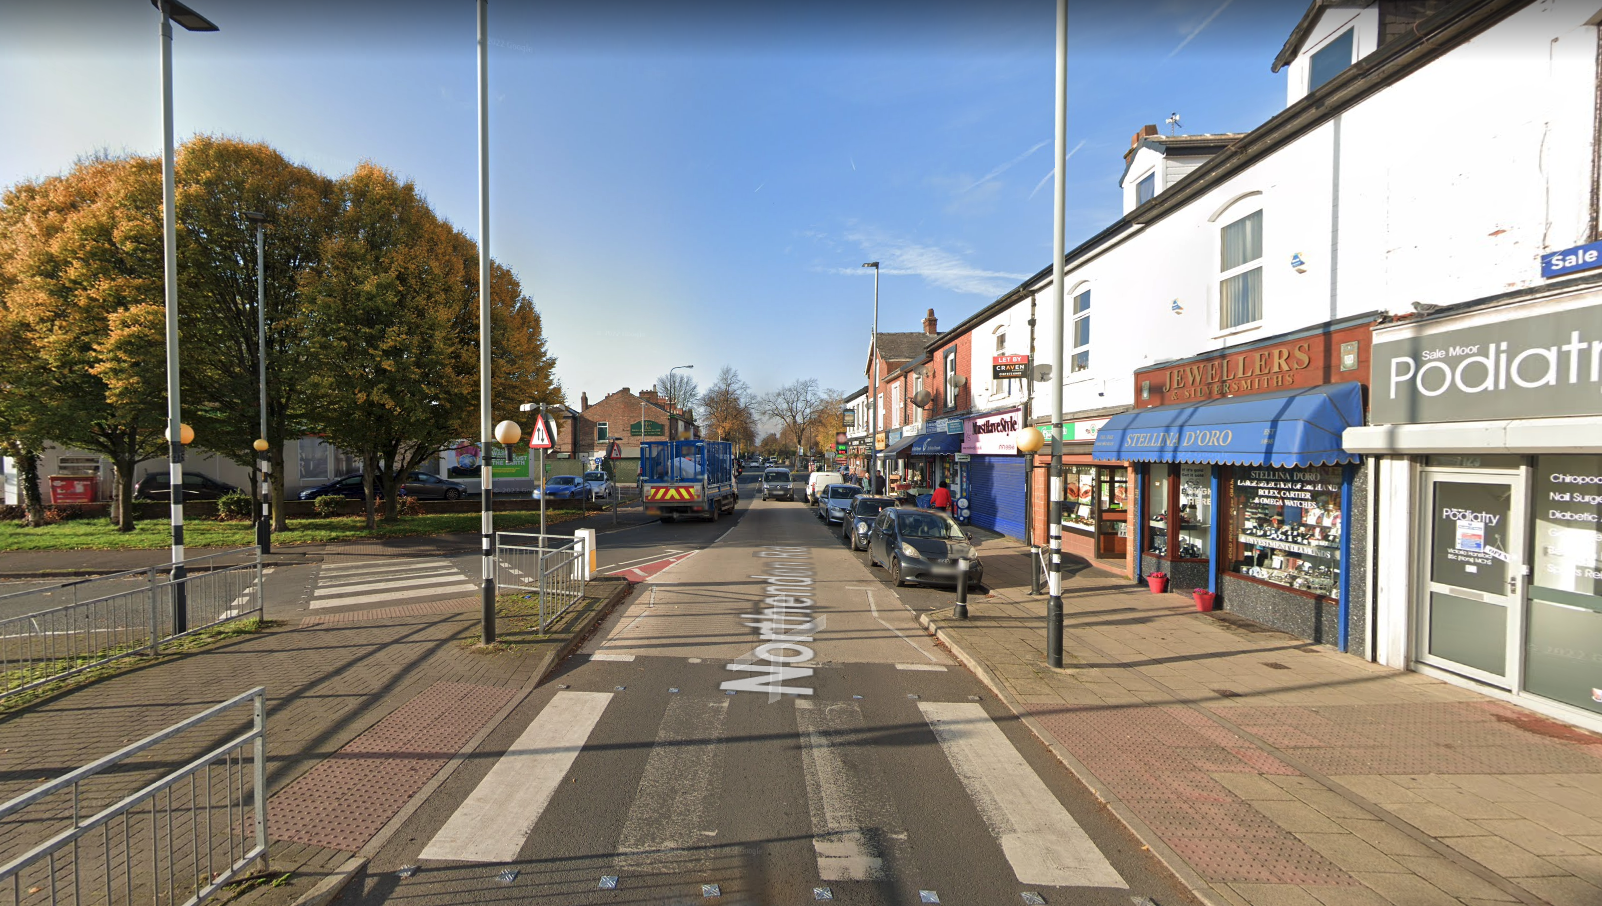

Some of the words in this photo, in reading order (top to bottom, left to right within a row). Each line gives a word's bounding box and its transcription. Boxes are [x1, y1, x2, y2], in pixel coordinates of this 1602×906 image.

[1551, 249, 1598, 270] Sale
[1422, 349, 1446, 361] Sale
[1449, 344, 1480, 358] Moor
[1163, 343, 1311, 393] JEWELLERS
[1390, 331, 1602, 400] Podiatr
[1171, 391, 1178, 400] &
[1184, 373, 1295, 400] SILVERSMITHS
[1125, 432, 1180, 447] STELLINA
[1183, 429, 1232, 446] D'ORO
[1251, 471, 1290, 480] STELLINA
[1294, 472, 1320, 481] D'ORO
[1258, 481, 1292, 489] SELECTION
[1315, 484, 1338, 492] HAND
[1260, 497, 1283, 505] OMEGA
[1284, 499, 1317, 508] WATCHES
[1549, 491, 1570, 501] Nail
[1443, 507, 1500, 526] Podiatry
[1549, 509, 1598, 522] Diabetic
[1247, 537, 1289, 551] INVESTMENT
[1290, 545, 1331, 559] DIAMONDS
